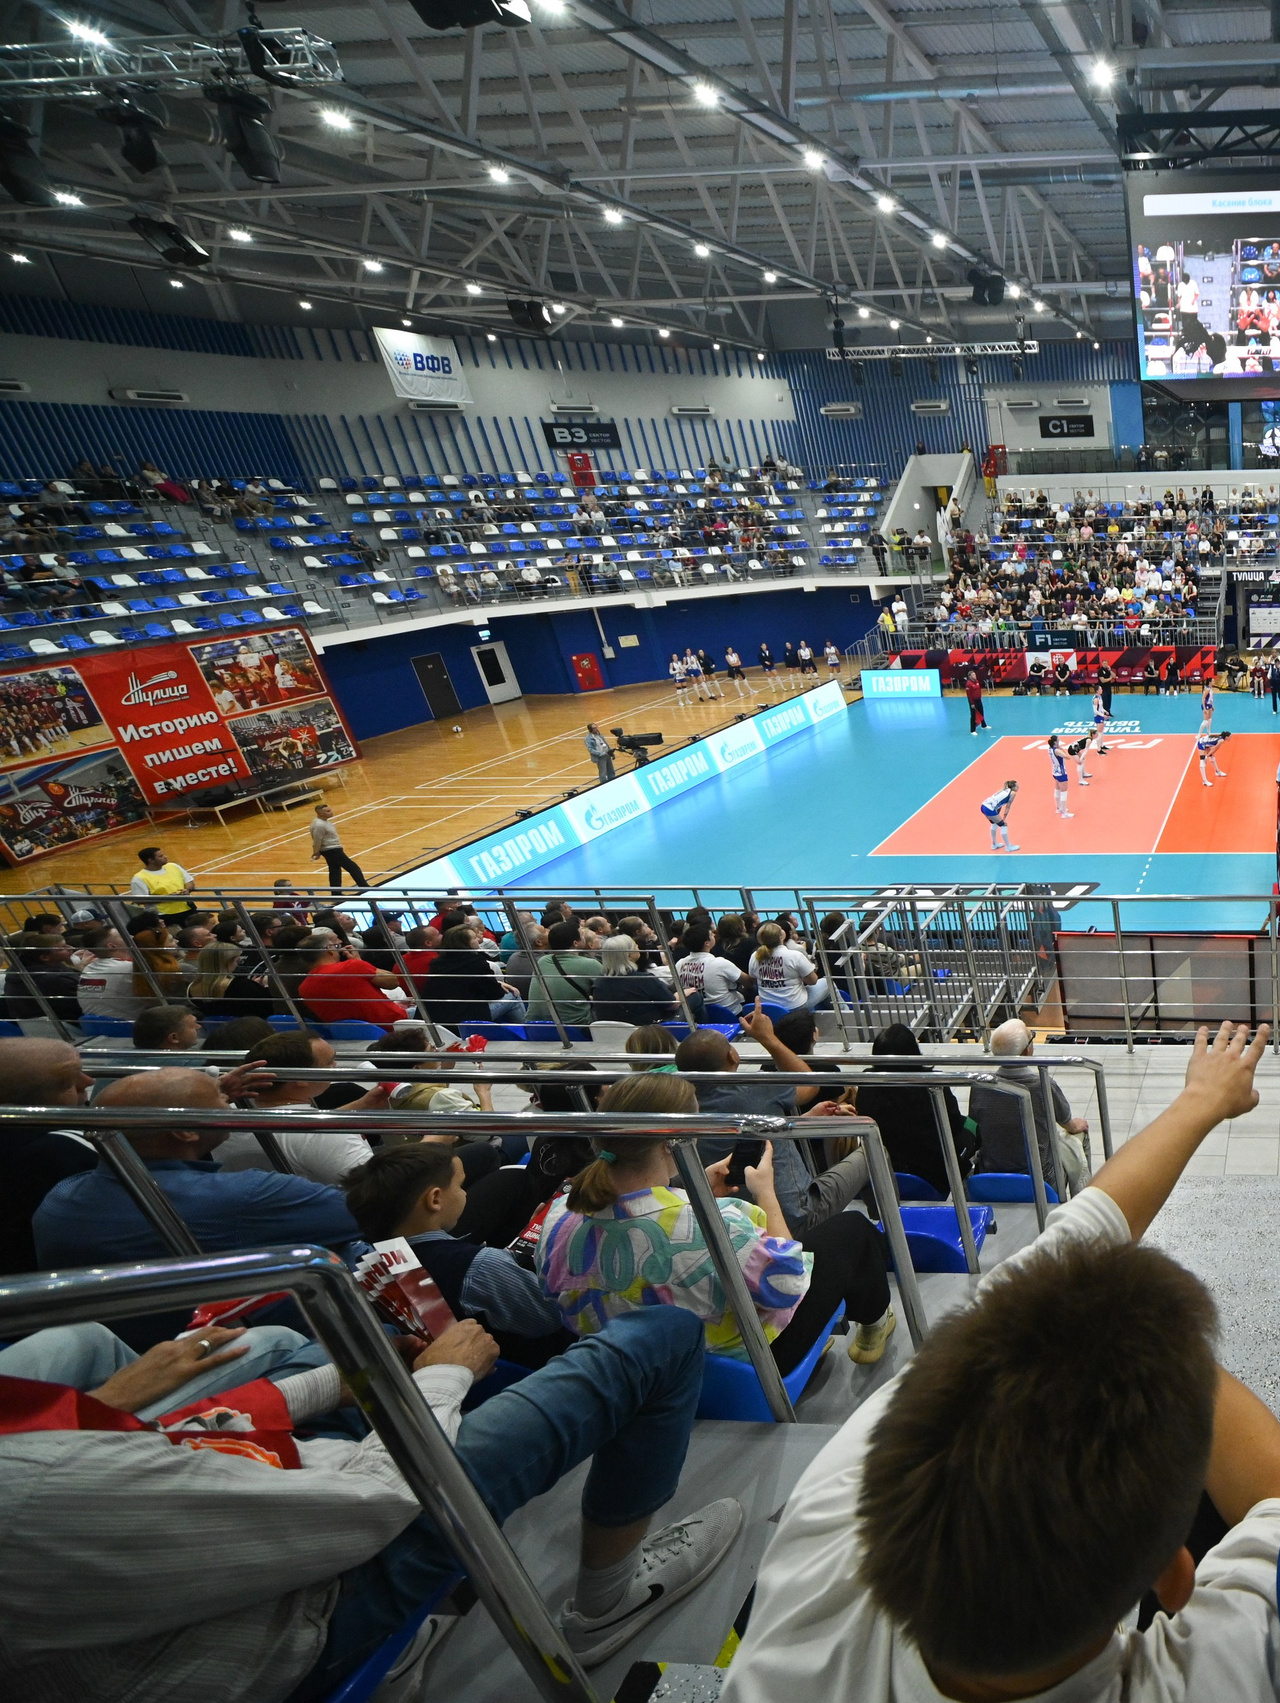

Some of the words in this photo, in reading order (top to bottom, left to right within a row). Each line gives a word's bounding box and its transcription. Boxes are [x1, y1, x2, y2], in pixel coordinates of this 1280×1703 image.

[1212, 198, 1247, 207] Касание
[1248, 197, 1272, 206] блока
[413, 353, 452, 374] ВФВ
[553, 428, 587, 443] B3
[1049, 420, 1067, 433] C1
[1232, 571, 1264, 581] ТУЛИЦА
[1035, 634, 1051, 646] F1
[872, 676, 930, 692] ГАЗПРОМ
[118, 711, 219, 743] Историю
[762, 705, 806, 739] ГАЗПРОМ
[144, 738, 222, 768] пишем
[732, 740, 757, 760] ГАЗПРОМ
[153, 758, 238, 794] вместе!
[647, 751, 709, 796] ГАЗПРОМ
[602, 800, 640, 826] ГАЗПРОМ
[469, 819, 565, 883] ГАЗПРОМ
